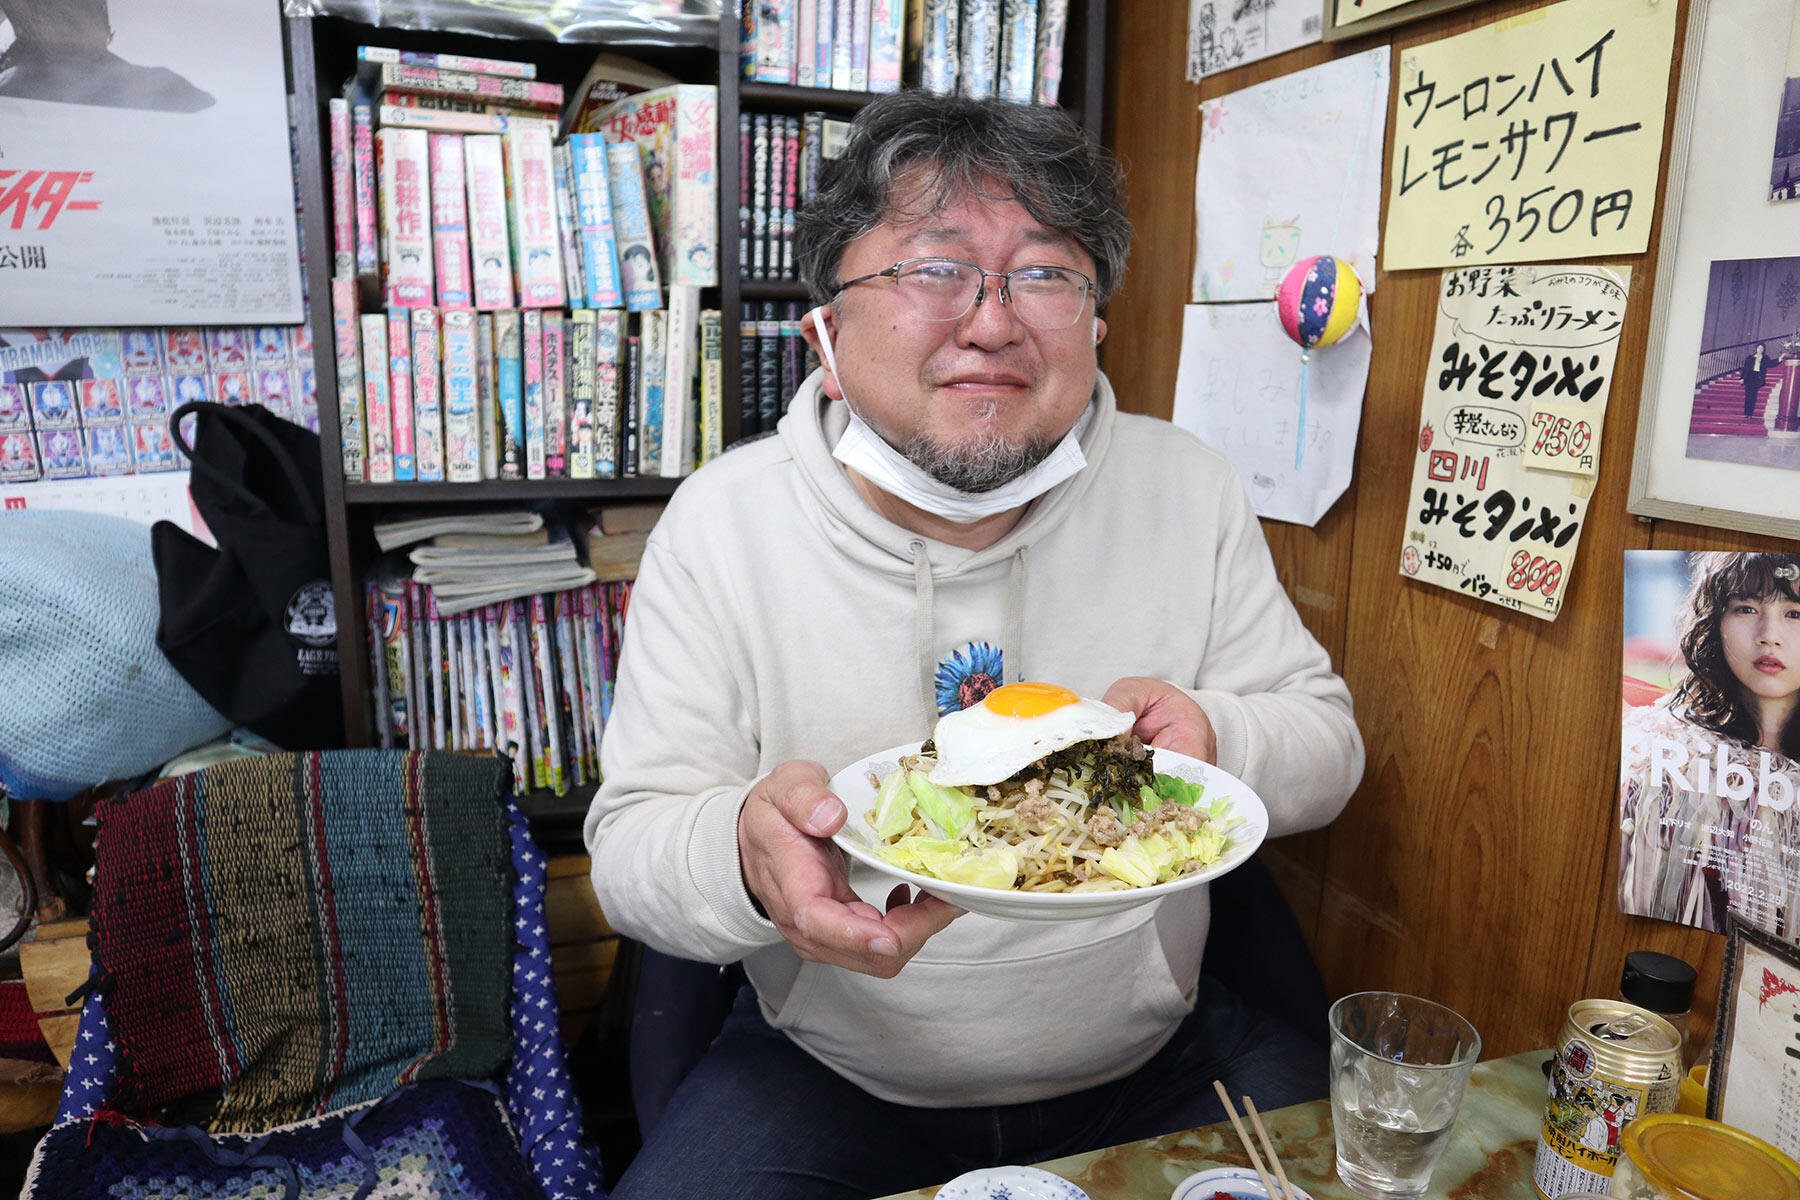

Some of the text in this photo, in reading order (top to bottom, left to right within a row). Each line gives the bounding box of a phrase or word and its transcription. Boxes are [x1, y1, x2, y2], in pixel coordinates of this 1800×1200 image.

[1404, 29, 1615, 129] ウーロンハイ
[1400, 111, 1642, 196] レモンサワー
[1450, 185, 1633, 258] 各 350円
[0, 245, 47, 270] 公開
[1446, 267, 1521, 298] お野菜
[1486, 301, 1623, 333] たっぷりラーメン
[70, 333, 103, 357] ORB
[1439, 342, 1605, 402] みそタンメン
[1453, 409, 1519, 441] 辛党さんなら
[1532, 412, 1592, 469] 750 円
[1428, 449, 1490, 491] 四川
[1419, 487, 1579, 548] みそタンメン
[1460, 574, 1499, 598] バター
[1507, 549, 1563, 608] 800 円
[1650, 738, 1800, 812] Ribb
[1750, 818, 1775, 836] のん
